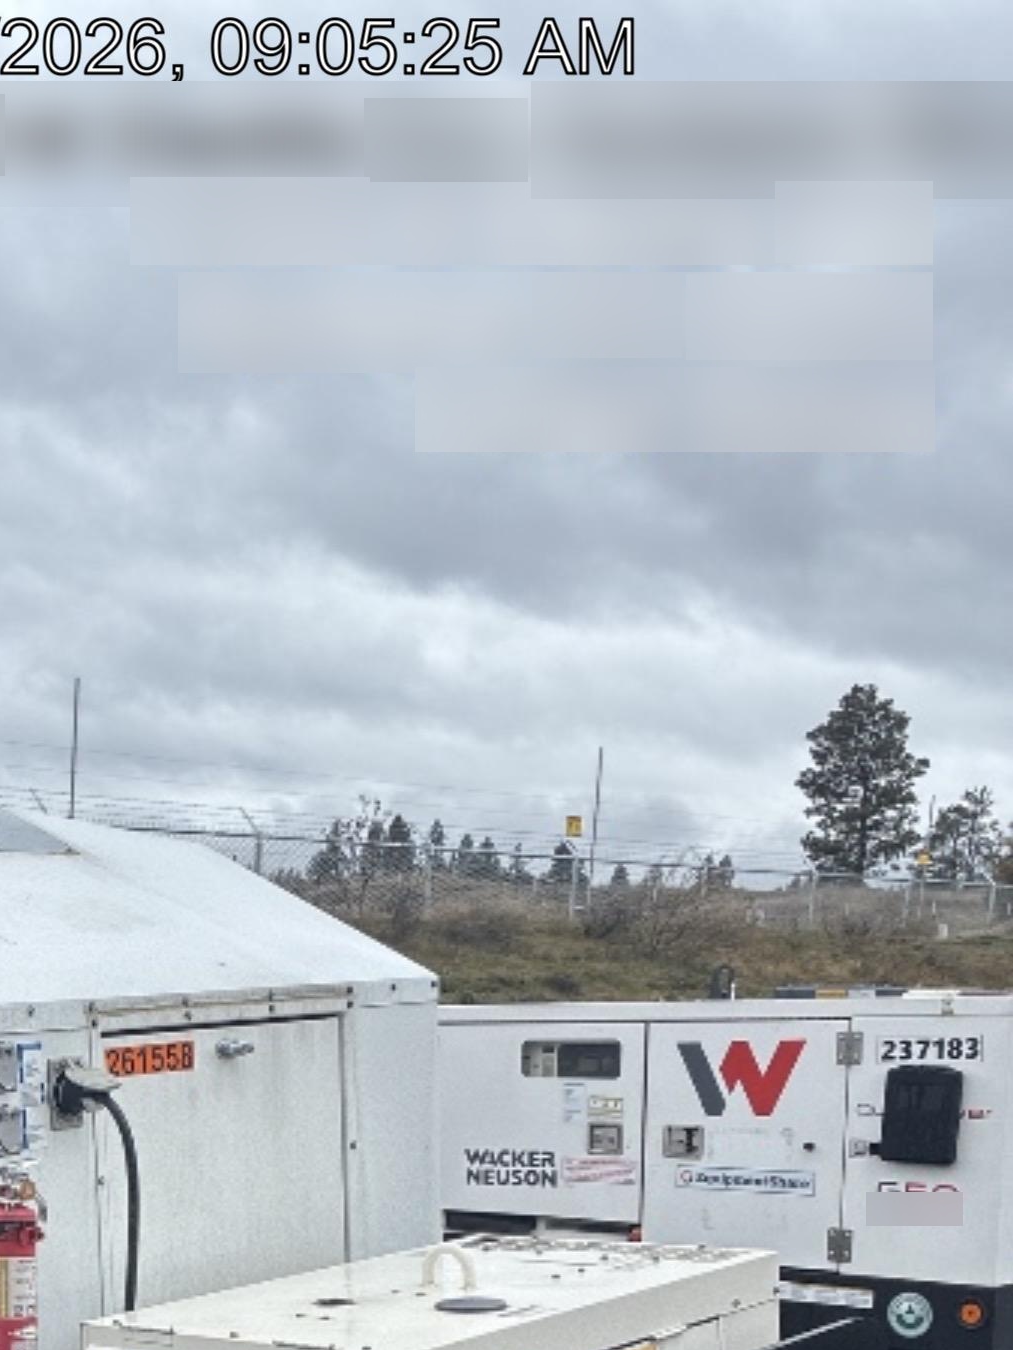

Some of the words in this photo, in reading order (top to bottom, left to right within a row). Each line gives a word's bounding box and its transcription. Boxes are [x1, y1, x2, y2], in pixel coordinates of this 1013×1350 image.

[881, 1037, 979, 1060] 237183
[107, 1043, 194, 1077] 261558
[465, 1149, 555, 1167] WACKER
[466, 1168, 557, 1187] NEUSON
